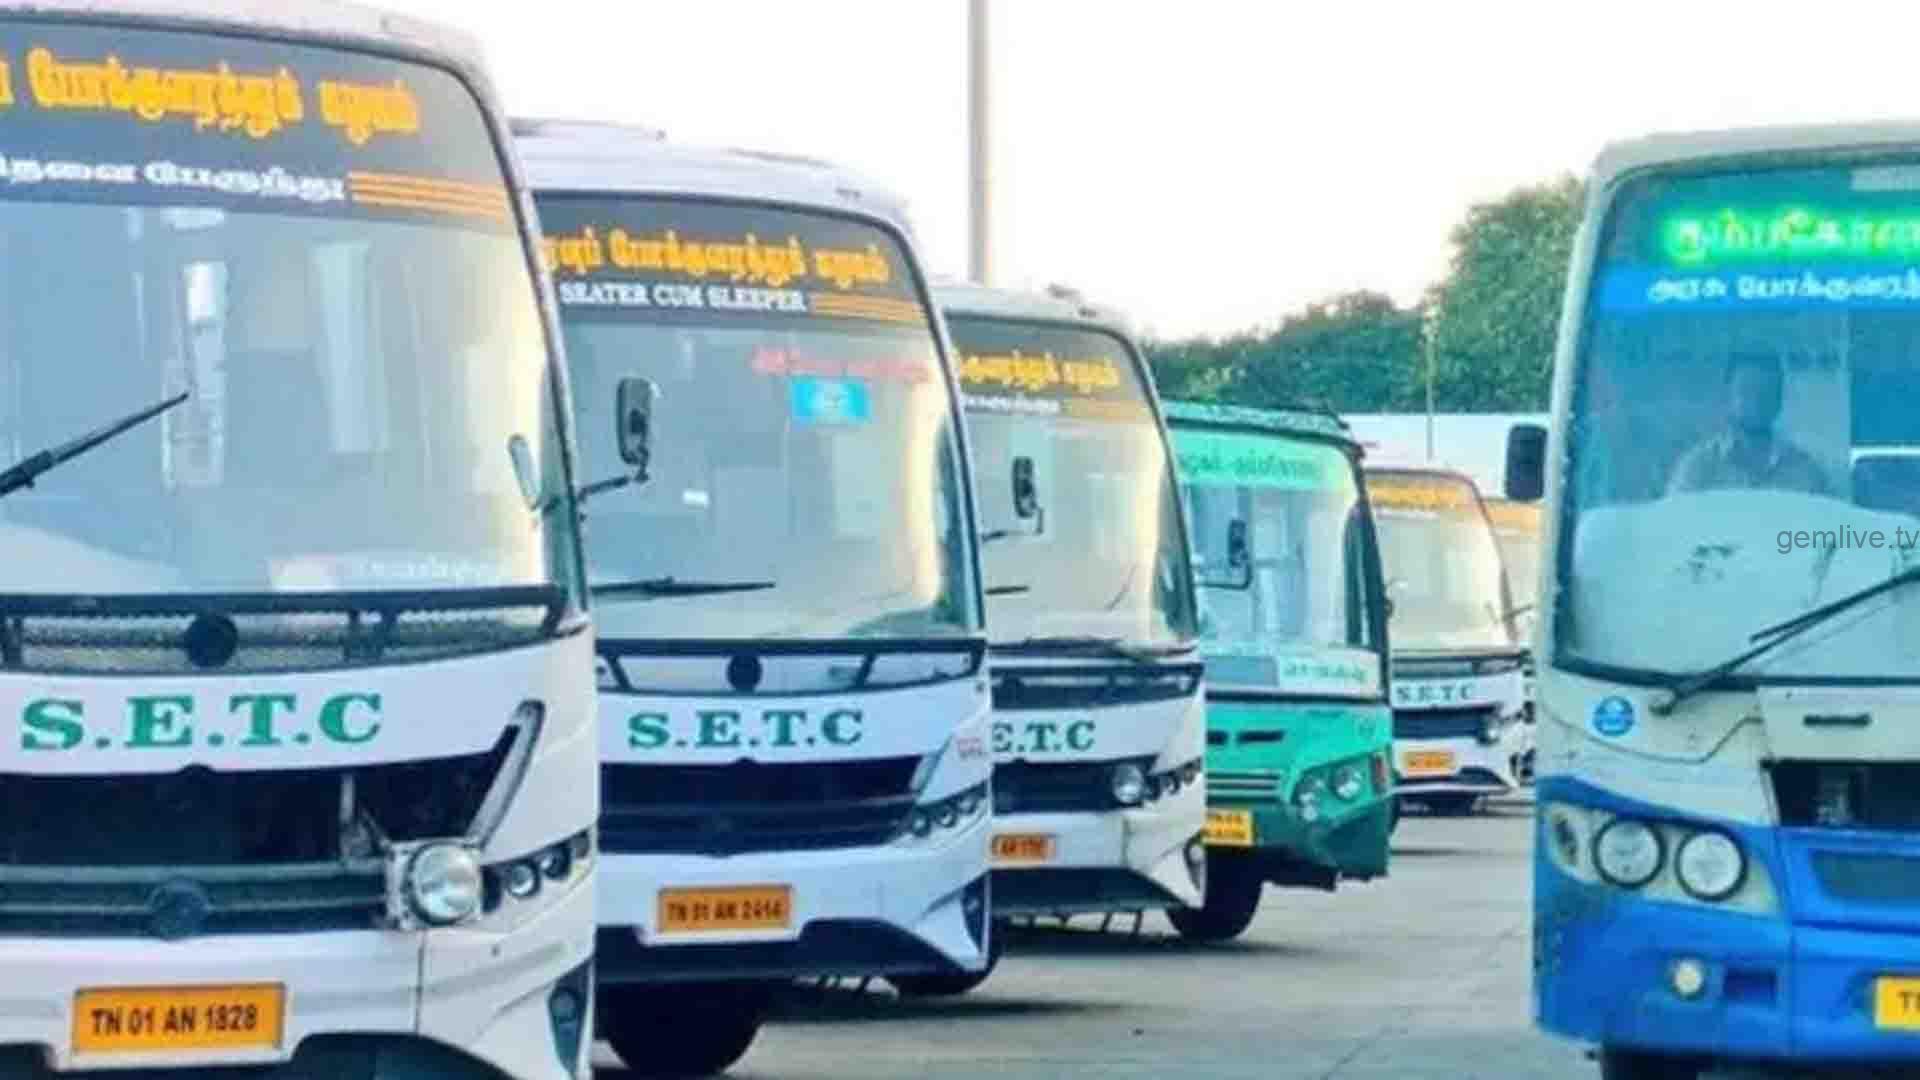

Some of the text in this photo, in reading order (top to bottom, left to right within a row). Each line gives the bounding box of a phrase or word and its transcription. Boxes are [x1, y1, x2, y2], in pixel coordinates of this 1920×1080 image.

[558, 280, 807, 313] SEATER CUM SLEEPER
[20, 693, 383, 751] S.E.T.C
[627, 709, 863, 749] S.E.T.C
[91, 1002, 260, 1036] TN 01 AN 1828
